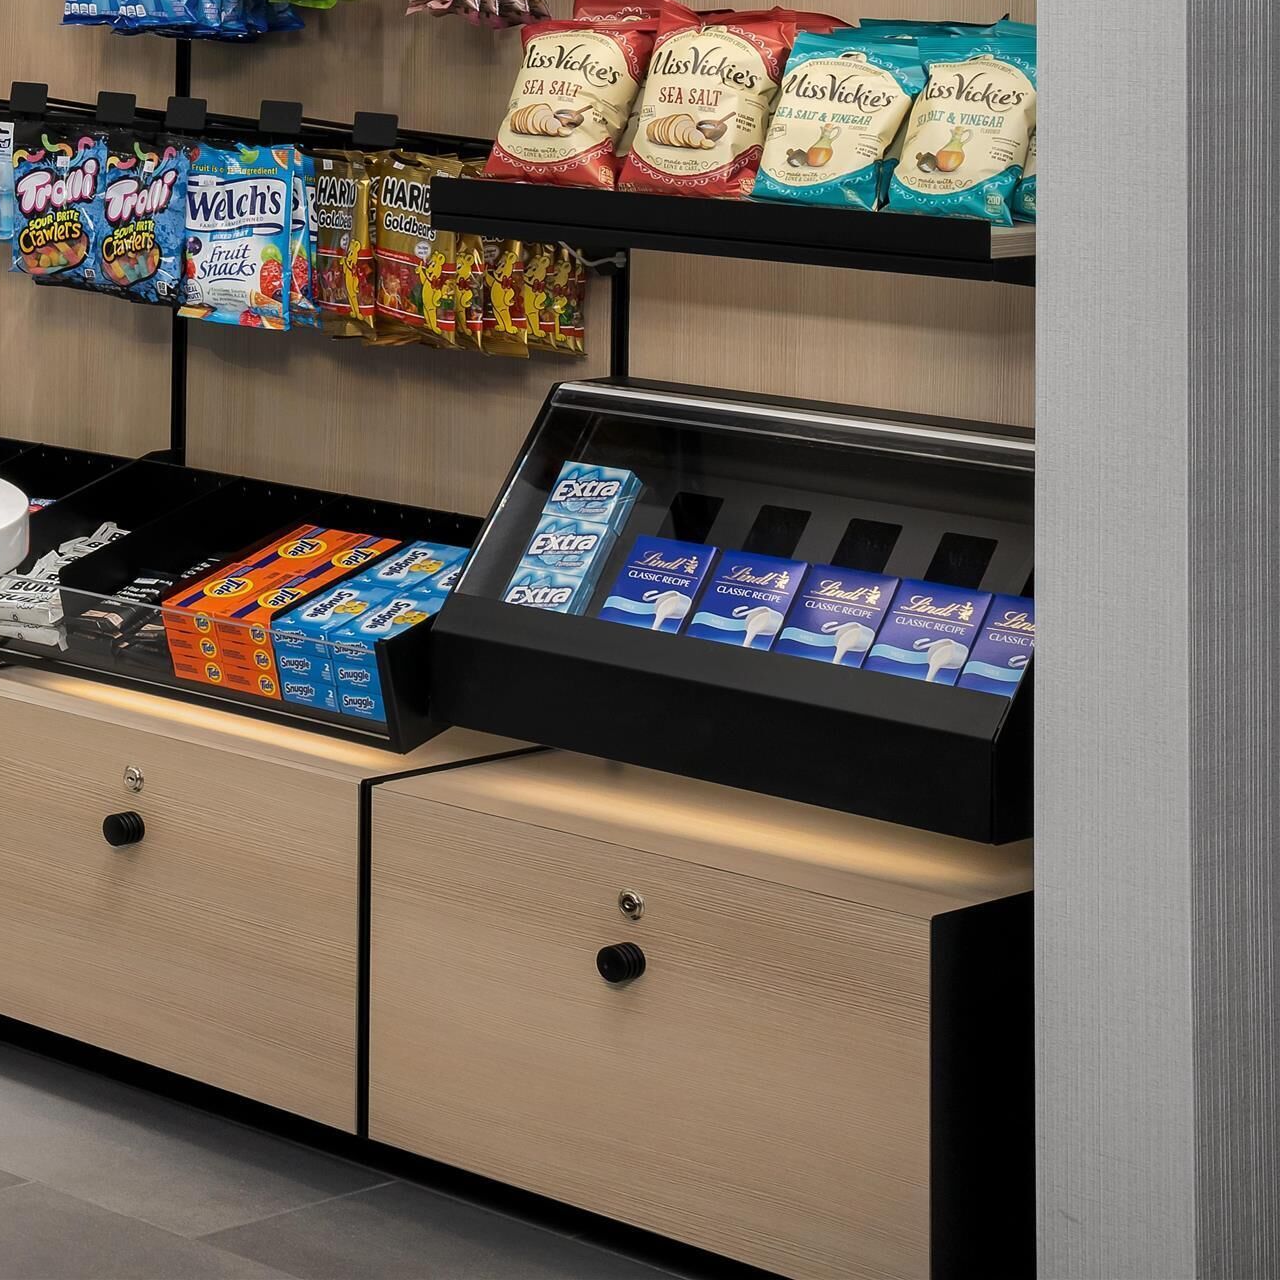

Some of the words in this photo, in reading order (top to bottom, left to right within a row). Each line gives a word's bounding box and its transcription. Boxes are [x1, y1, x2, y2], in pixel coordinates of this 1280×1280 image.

[689, 46, 758, 89] Vickie's
[658, 86, 684, 105] SEA
[688, 88, 723, 107] SALT
[831, 113, 873, 126] VINEGAR
[17, 159, 97, 213] Trolli
[187, 183, 282, 222] Welch's
[29, 215, 53, 231] SOUR
[383, 212, 436, 241] Goldbears
[19, 221, 81, 255] Crawlers
[209, 242, 251, 263] Fruit
[196, 257, 257, 280] Snacks
[551, 479, 620, 502] Extra
[528, 533, 598, 556] Extra
[635, 551, 686, 571] Lindt
[628, 570, 662, 585] CLASSIC
[663, 575, 691, 588] RECIPE
[206, 666, 220, 679] Tide
[281, 657, 310, 671] Snuggle
